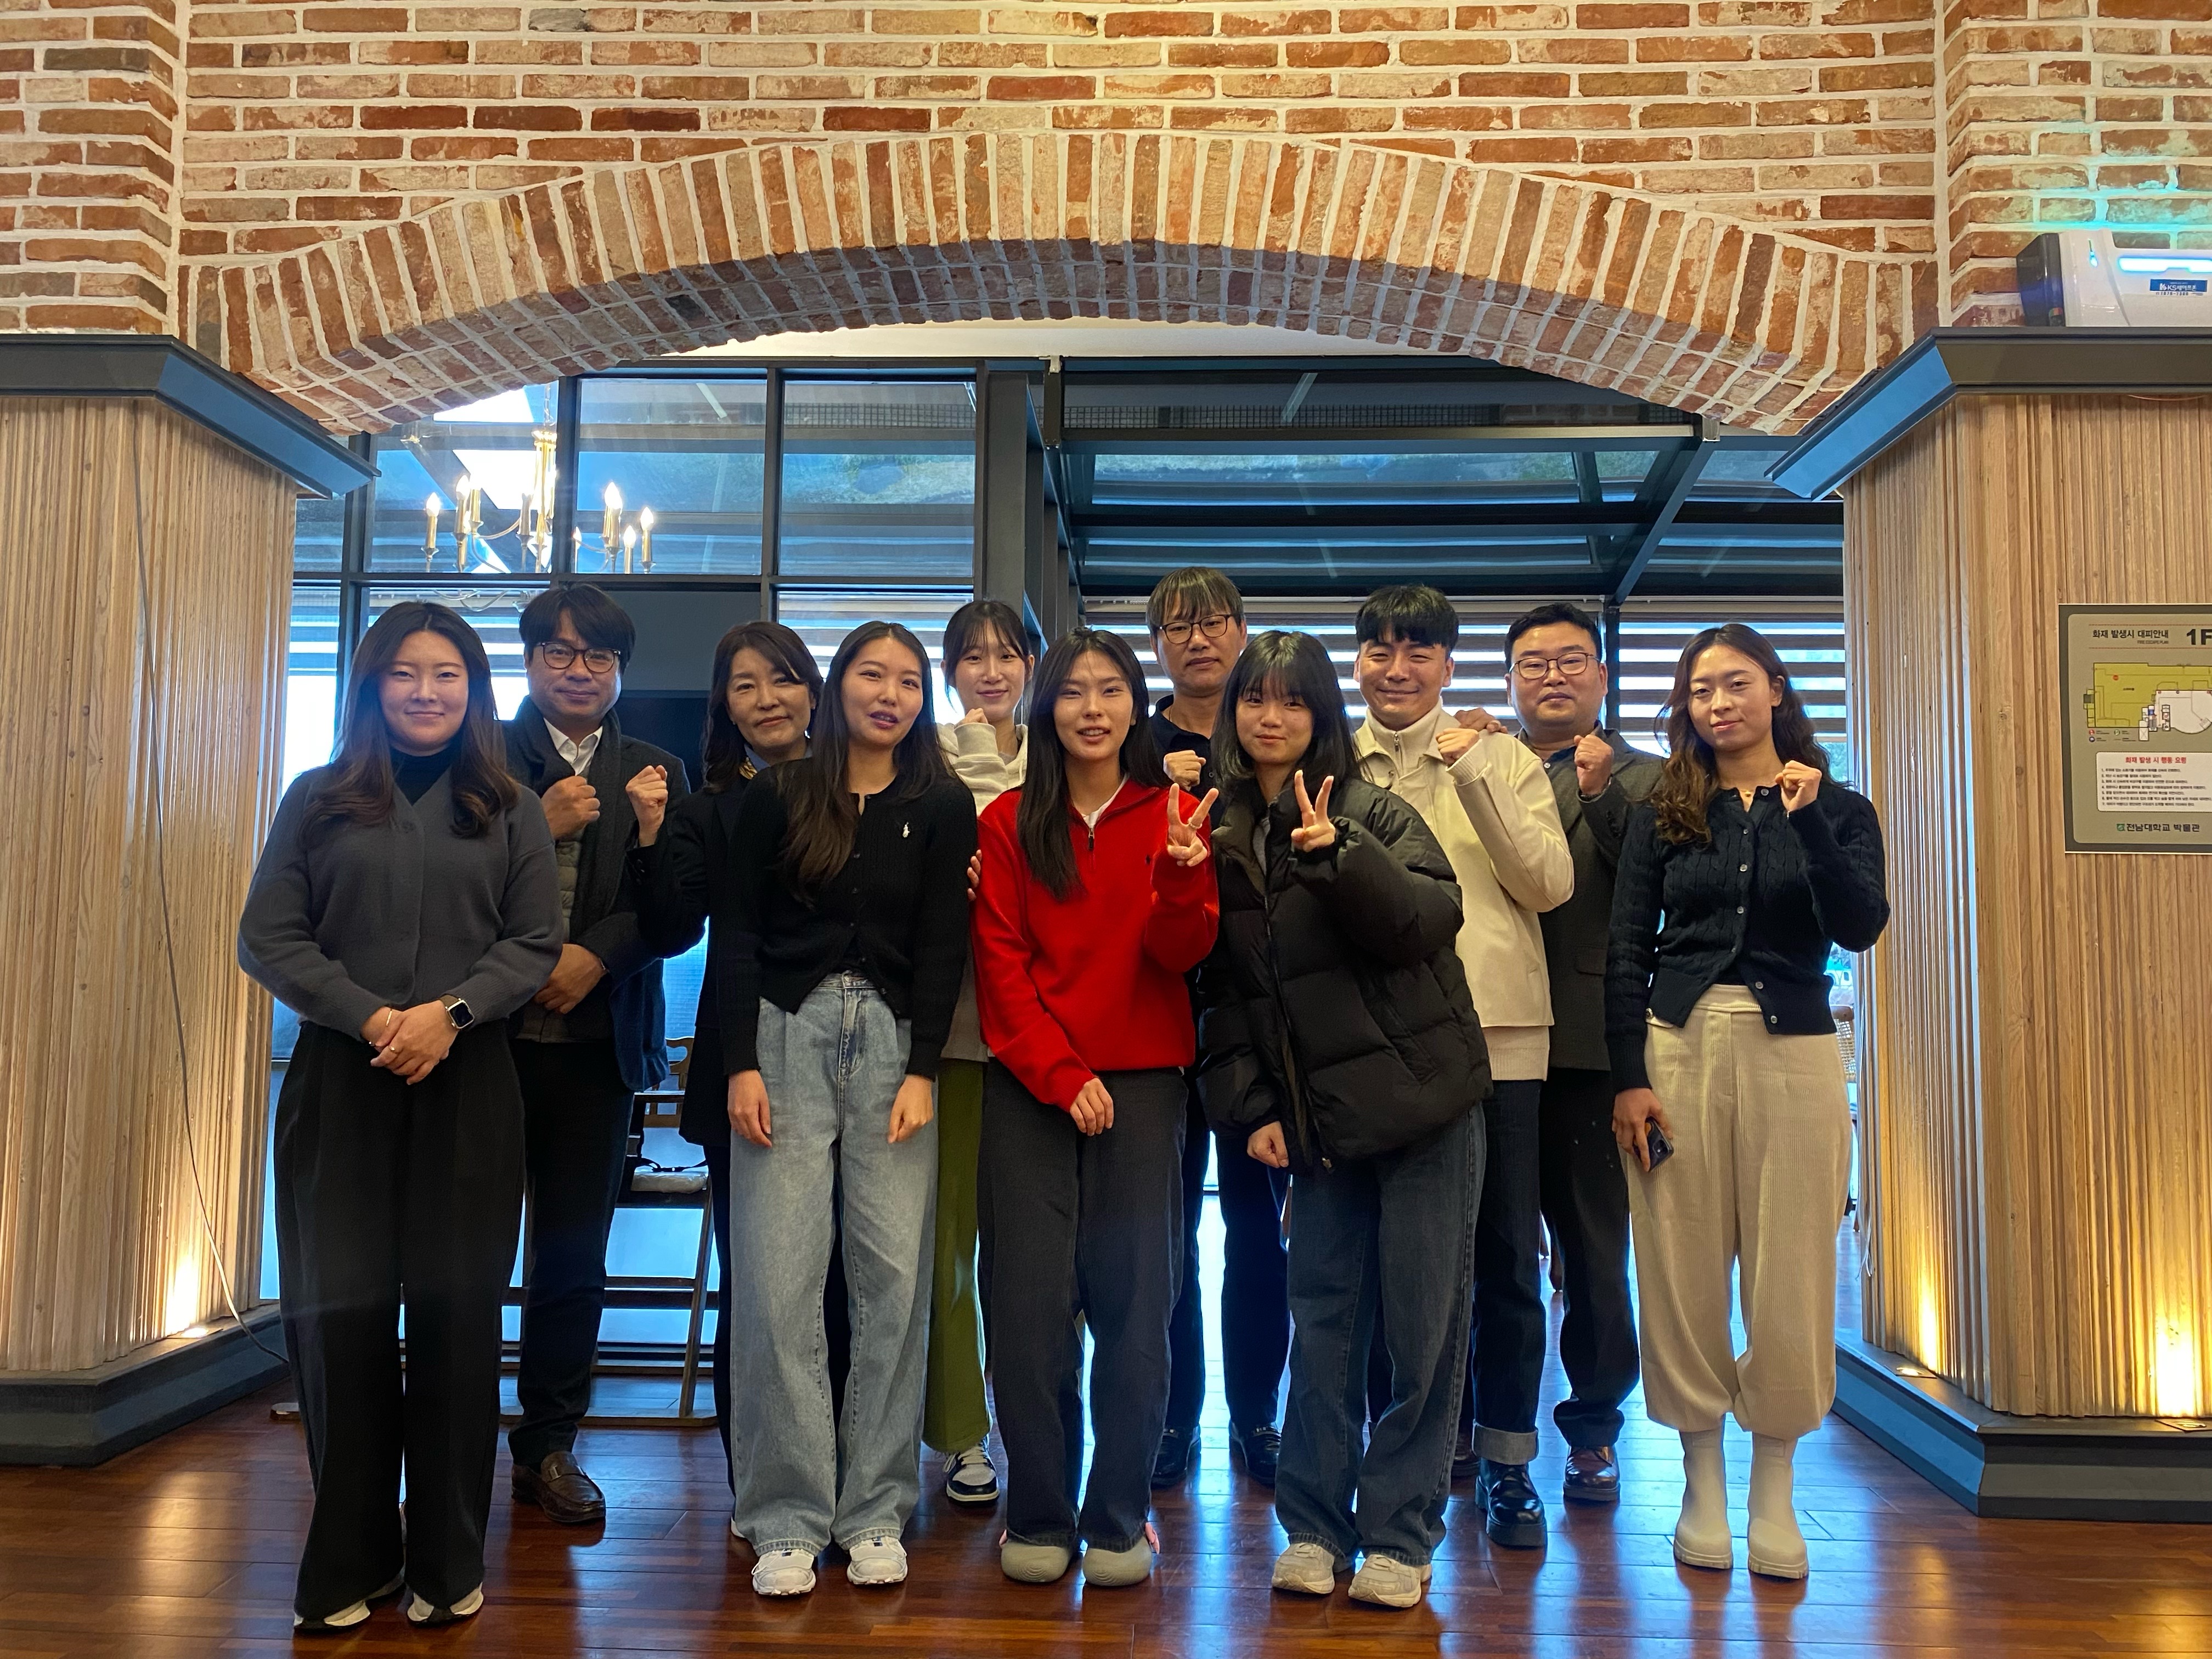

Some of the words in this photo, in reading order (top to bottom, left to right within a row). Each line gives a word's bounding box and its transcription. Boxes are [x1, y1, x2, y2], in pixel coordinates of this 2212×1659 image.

[2092, 629, 2108, 639] 화재
[2111, 629, 2135, 639] 발생시
[2137, 629, 2169, 639] 대피안내
[2186, 629, 2212, 645] 1F
[2126, 823, 2171, 832] 전남대학교
[2173, 823, 2200, 832] 박물관
